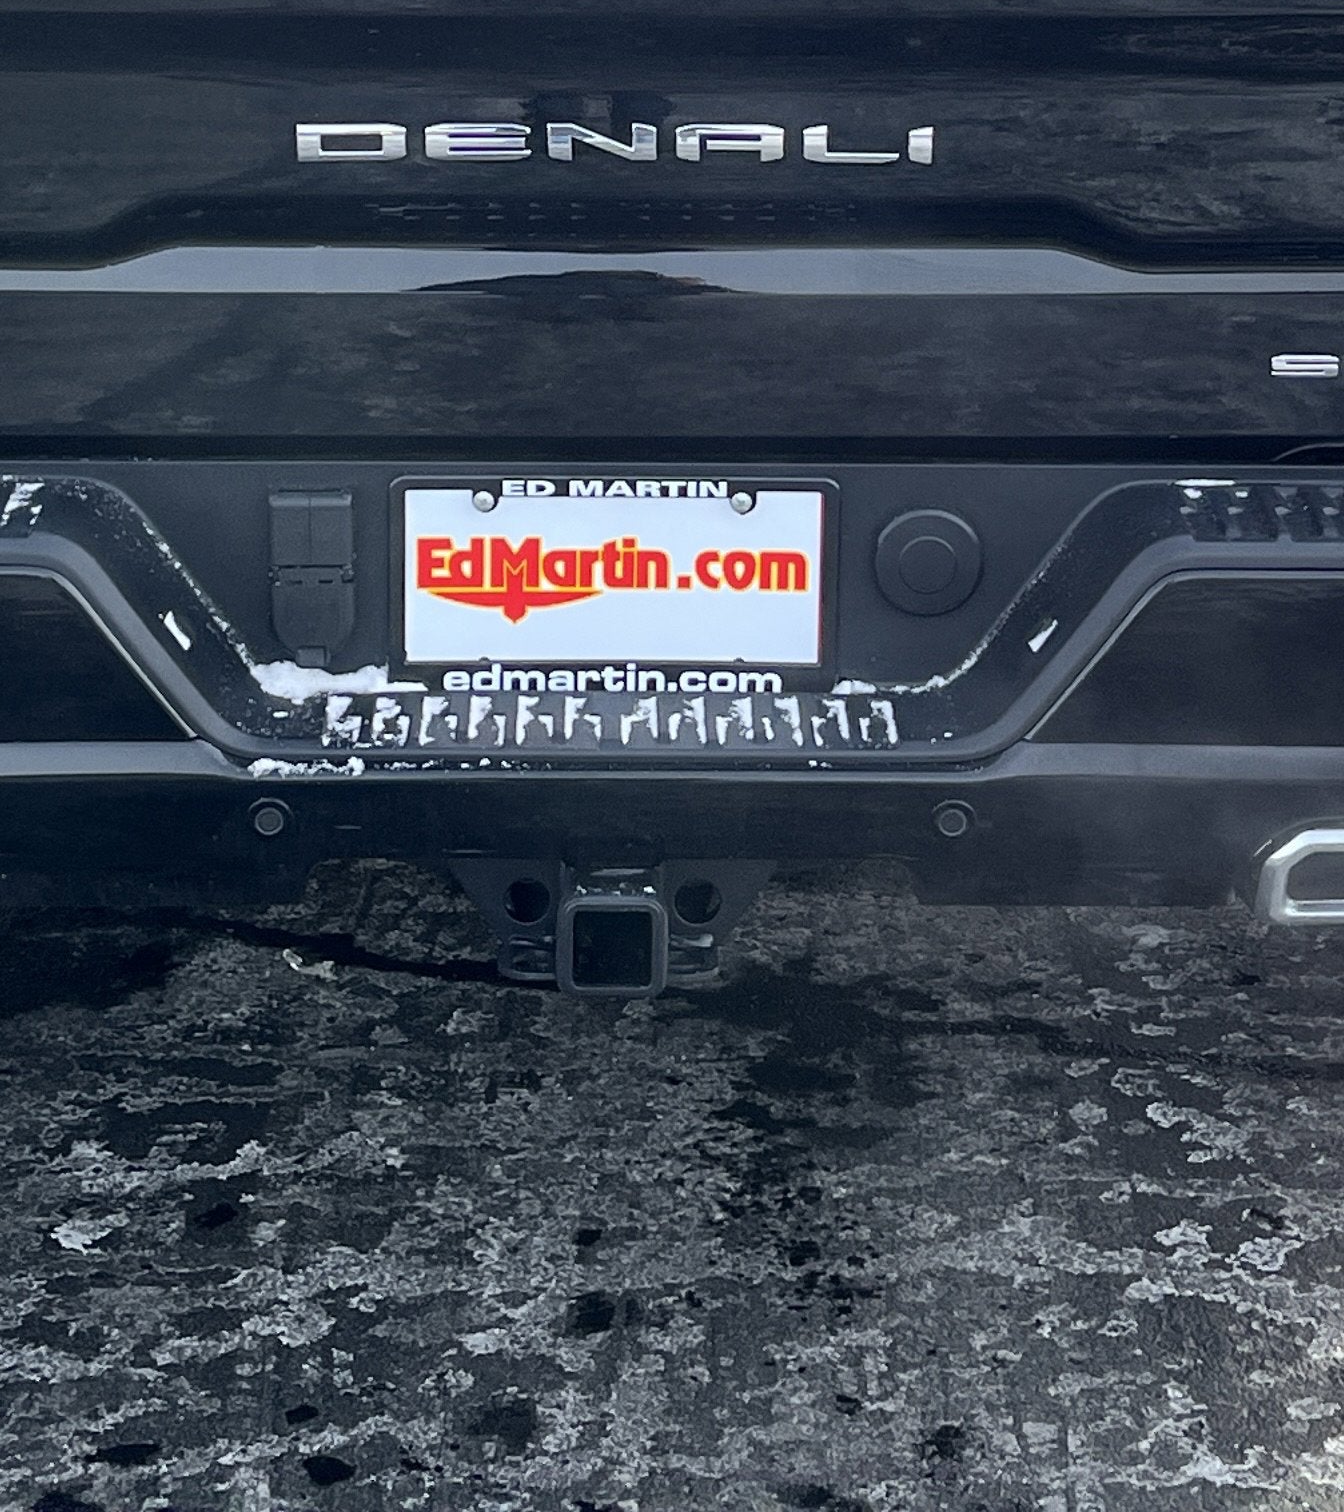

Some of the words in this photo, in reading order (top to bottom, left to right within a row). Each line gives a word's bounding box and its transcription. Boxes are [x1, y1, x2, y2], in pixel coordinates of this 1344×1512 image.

[295, 121, 935, 165] DENALI
[501, 479, 556, 499] ED
[568, 479, 728, 499] MARTIN
[415, 535, 810, 592] EdMartin.com
[442, 664, 782, 694] edmartin.com
